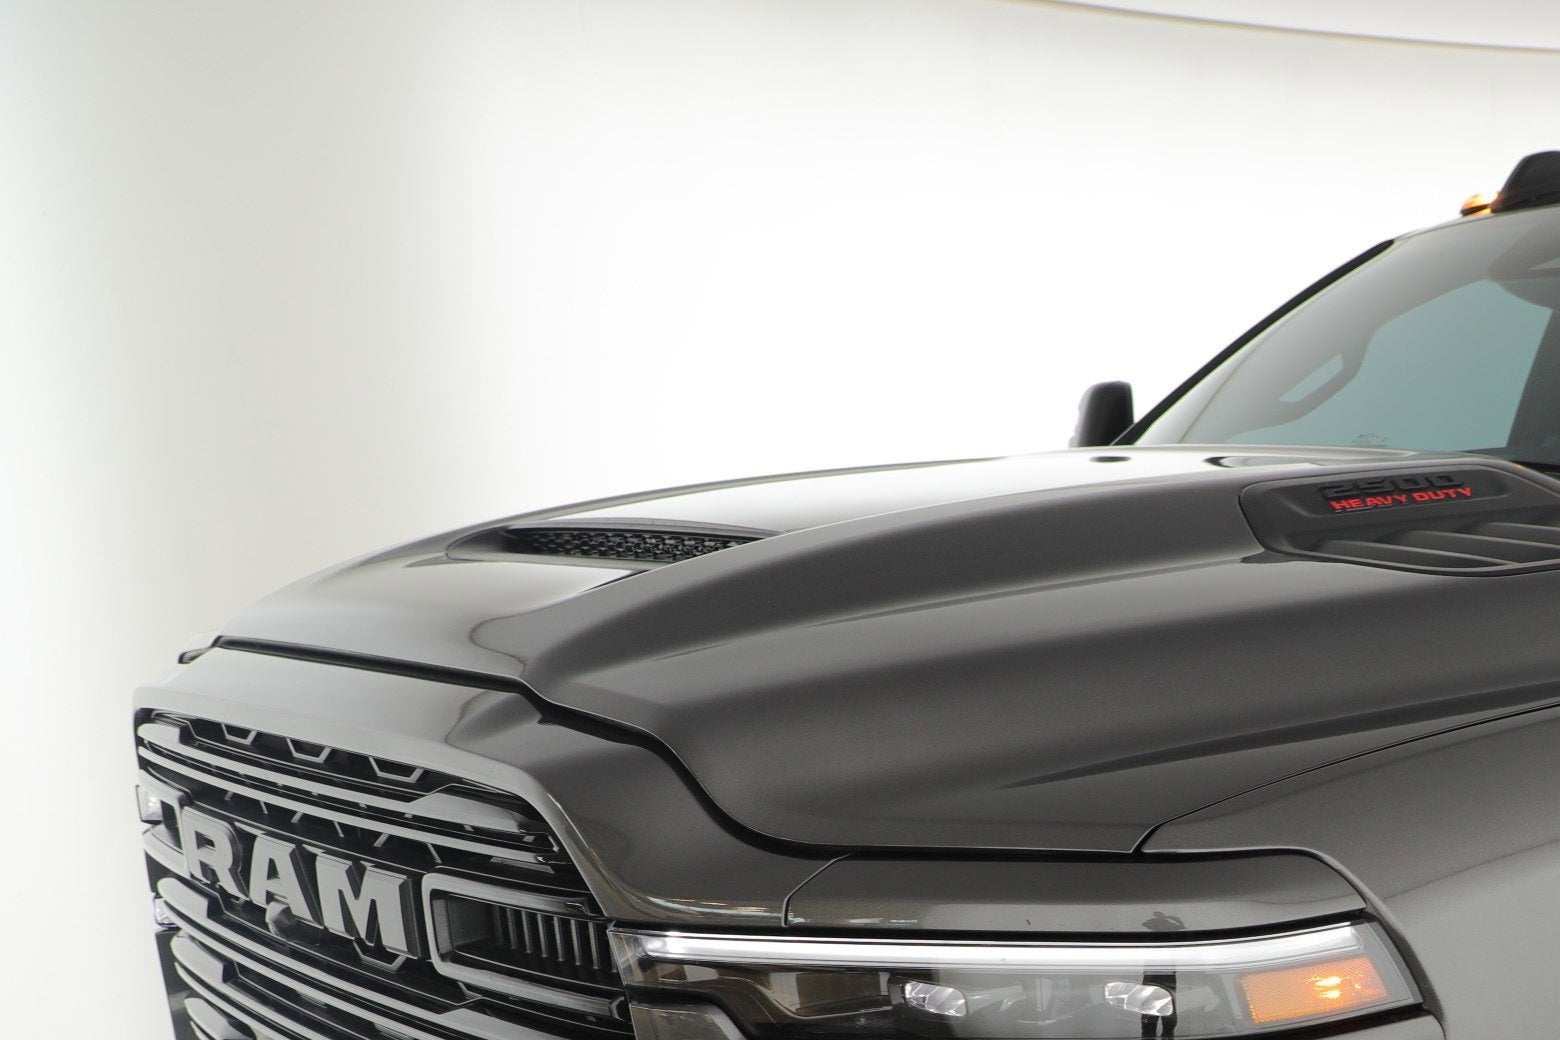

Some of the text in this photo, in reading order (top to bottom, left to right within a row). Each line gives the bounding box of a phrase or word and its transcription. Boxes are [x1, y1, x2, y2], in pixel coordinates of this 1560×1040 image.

[1317, 473, 1465, 500] 2500
[1329, 486, 1473, 512] HEAVY DUTY
[180, 804, 422, 960] RAM
